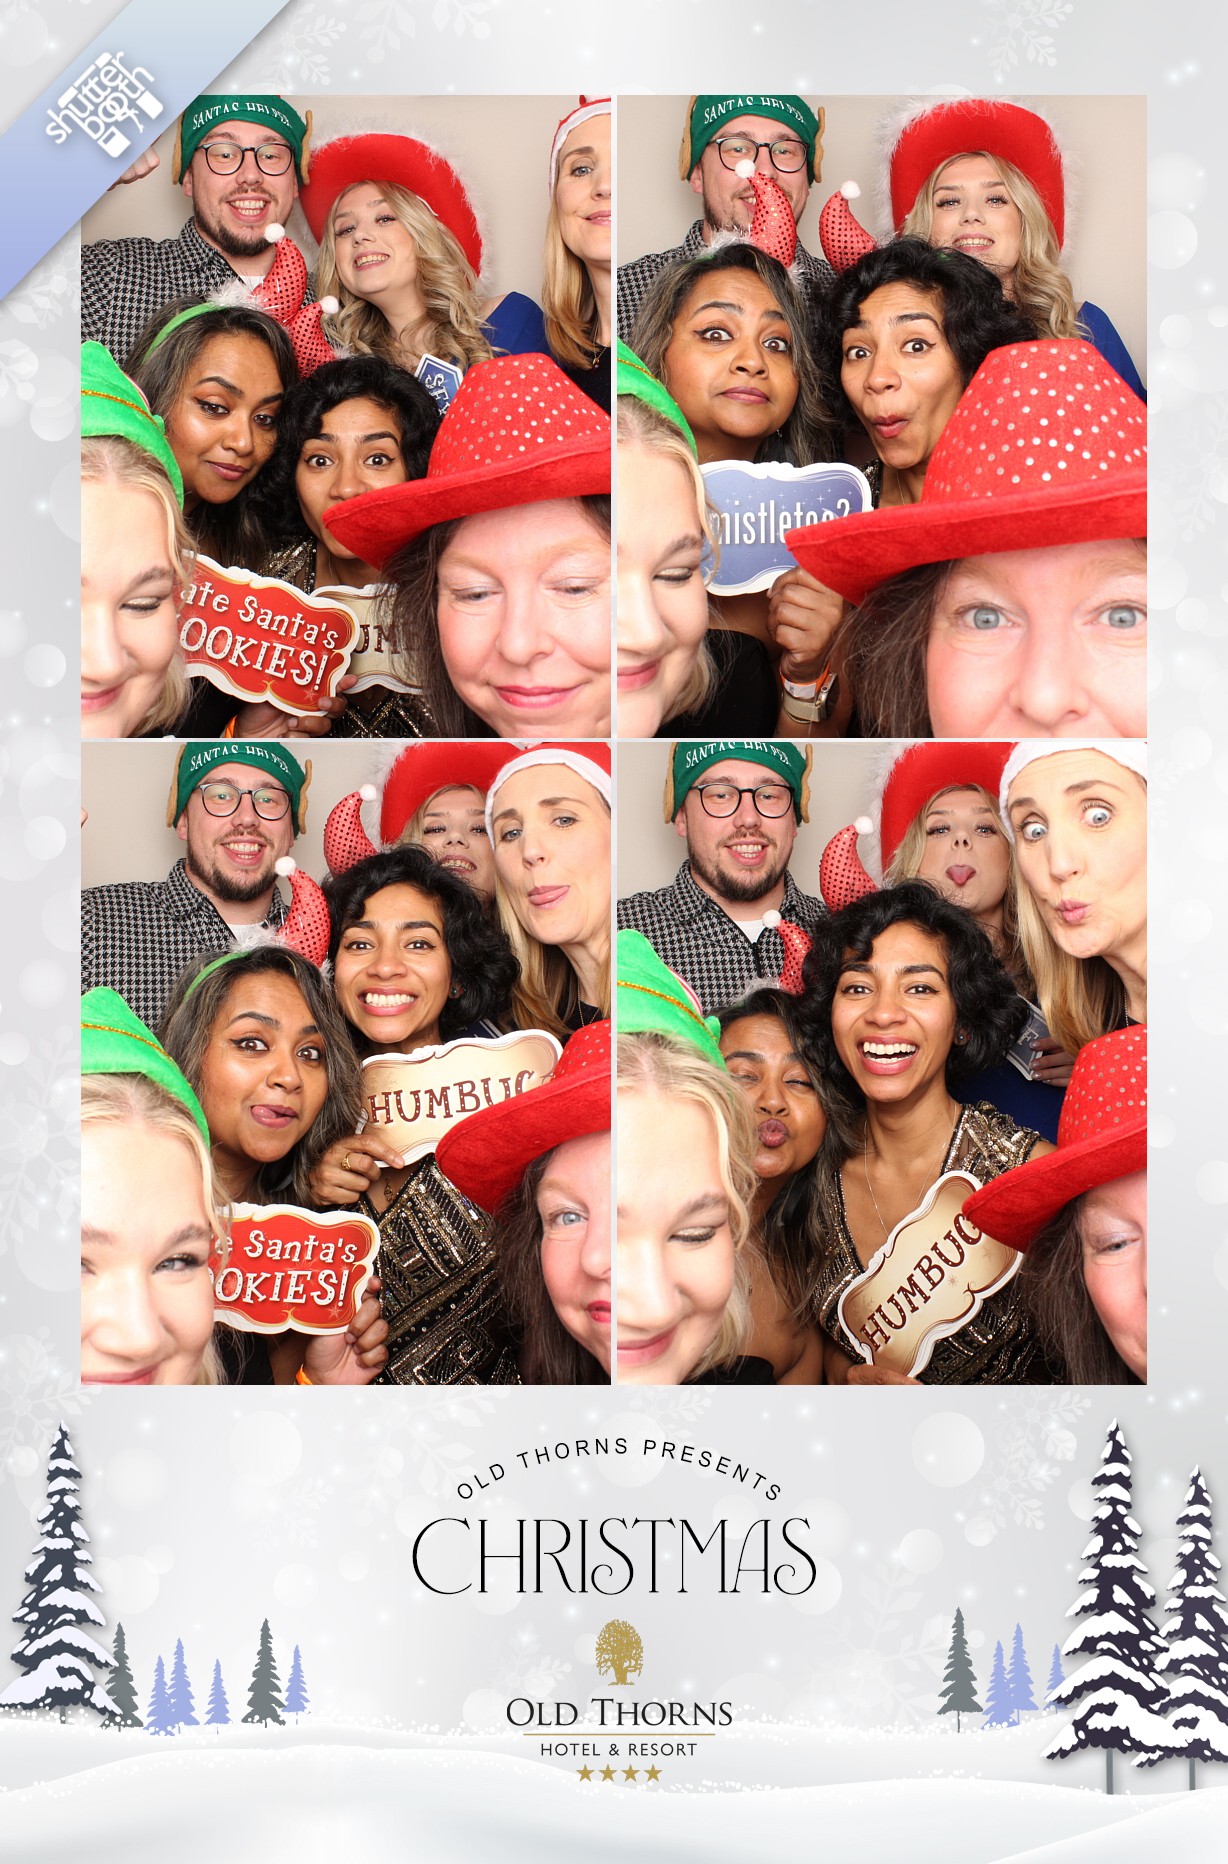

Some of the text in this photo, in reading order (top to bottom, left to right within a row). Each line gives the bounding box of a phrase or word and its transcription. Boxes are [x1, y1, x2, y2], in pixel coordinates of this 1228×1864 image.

[237, 595, 339, 650] Santa's
[177, 613, 329, 692] OOKIES!
[243, 1230, 358, 1263] Santa's
[208, 1266, 350, 1307] OKIES!
